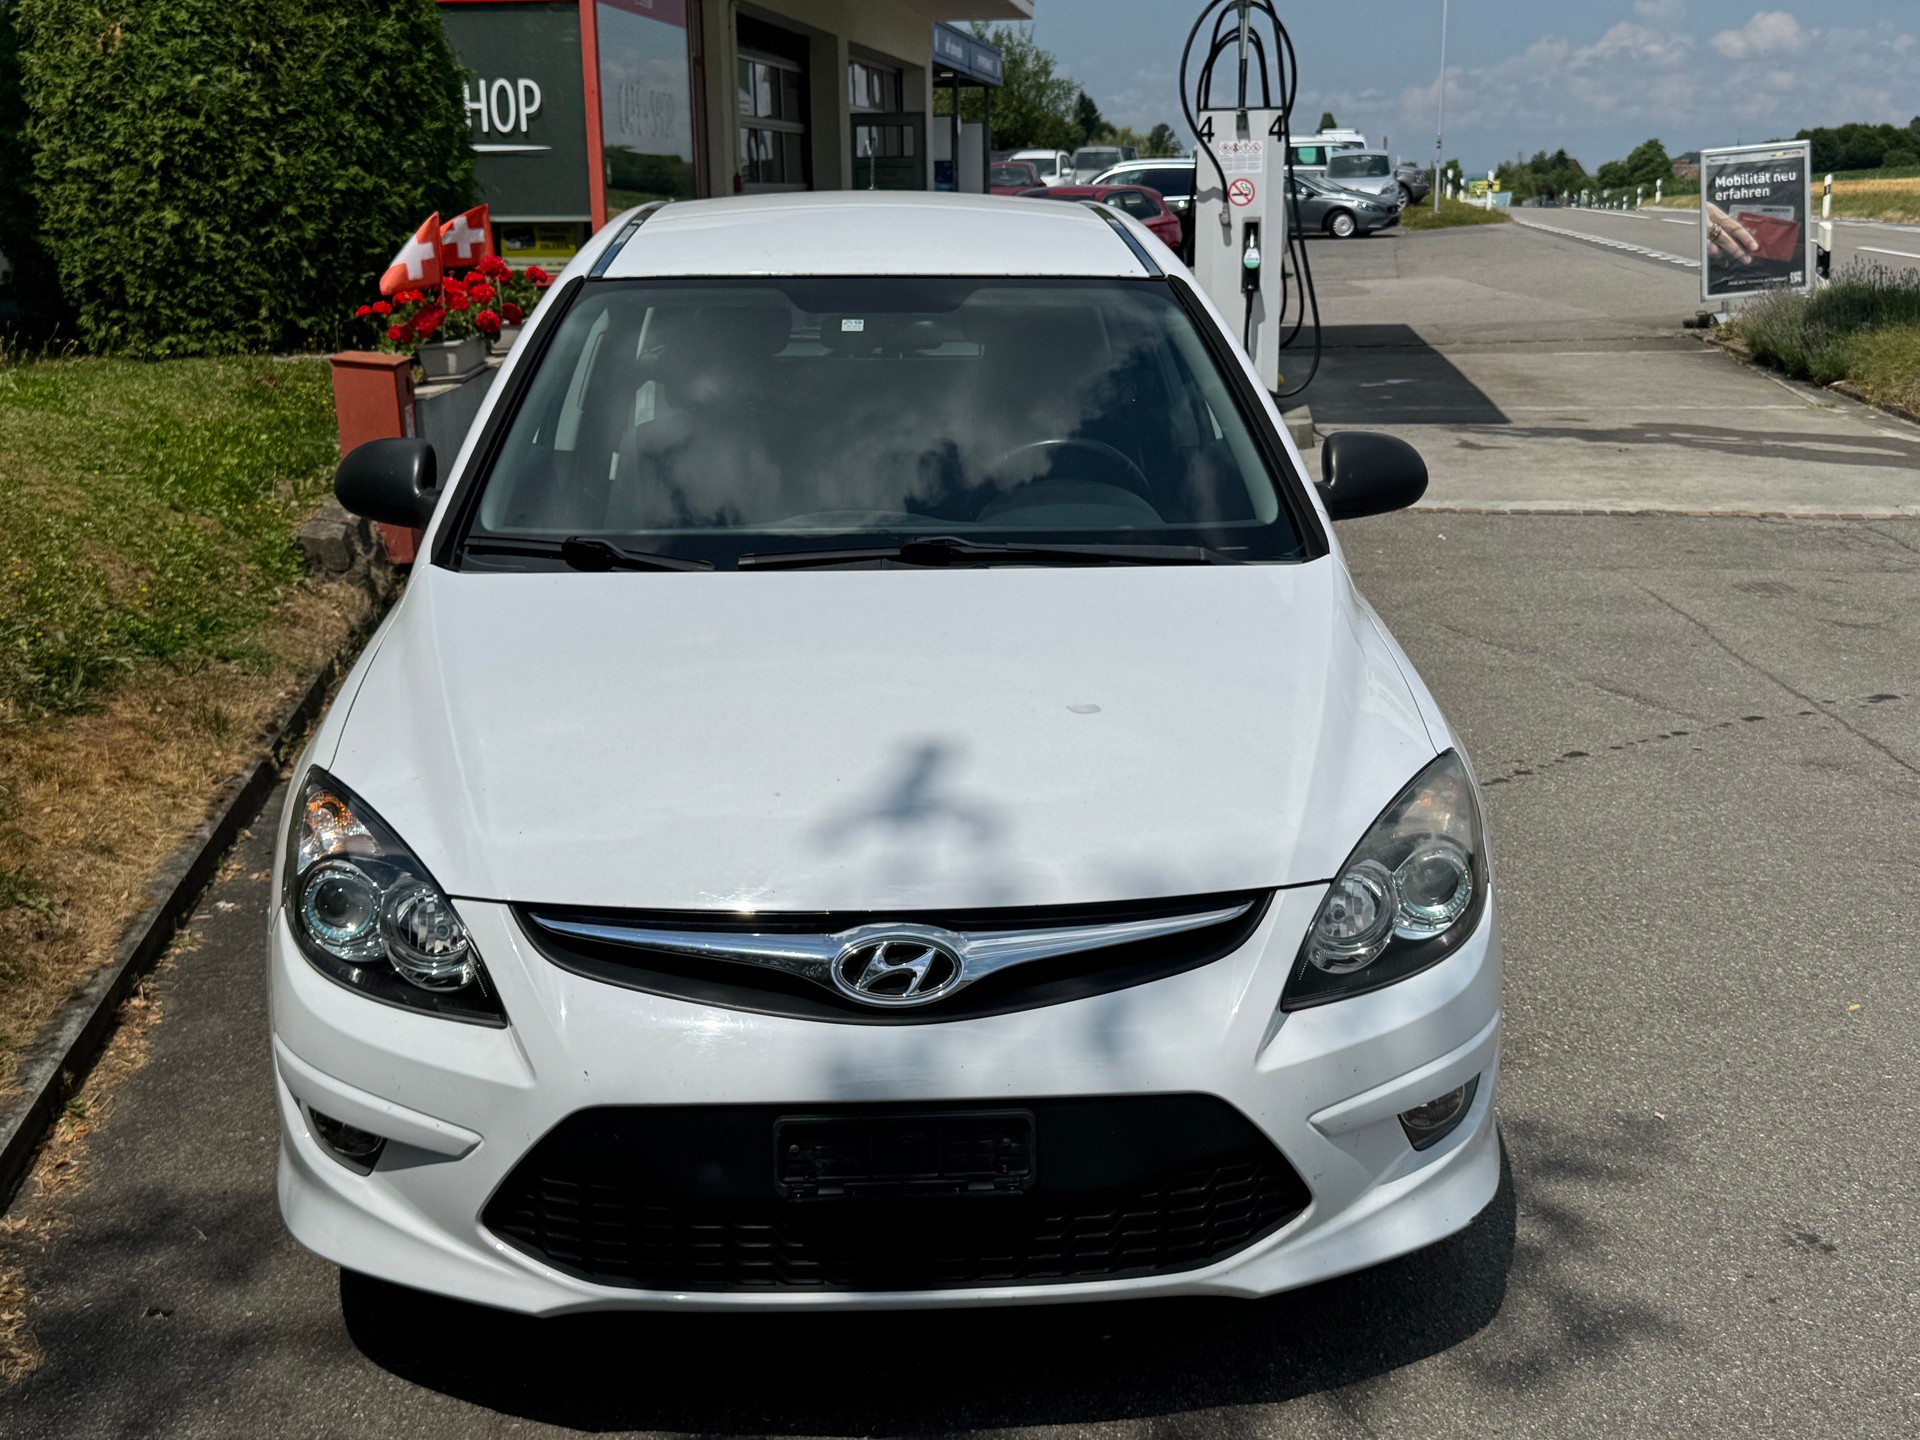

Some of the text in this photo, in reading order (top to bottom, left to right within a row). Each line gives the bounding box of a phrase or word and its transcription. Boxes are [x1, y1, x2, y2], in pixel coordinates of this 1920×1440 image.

[1199, 116, 1214, 143] 4
[1269, 115, 1286, 142] 4
[1714, 171, 1796, 188] Mobilität neu
[1714, 187, 1770, 201] erfahren
